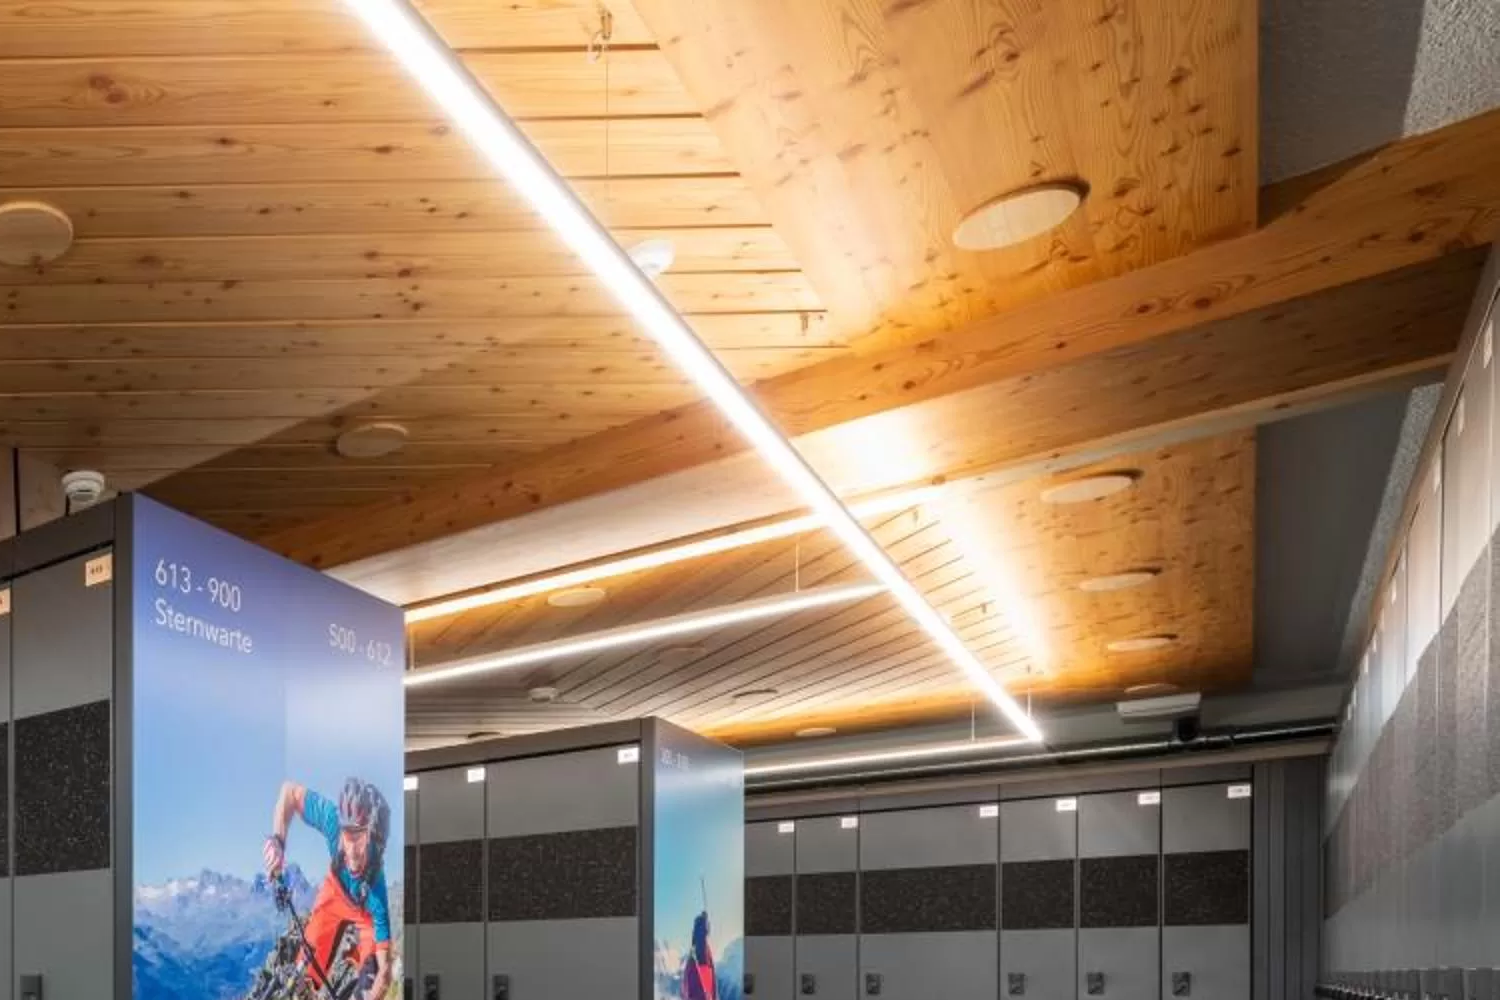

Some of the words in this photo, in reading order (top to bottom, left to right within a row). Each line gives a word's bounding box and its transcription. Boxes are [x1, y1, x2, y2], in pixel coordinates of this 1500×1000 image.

[155, 557, 192, 594] 613
[207, 576, 241, 613] 900
[155, 597, 253, 654] Sternwarte
